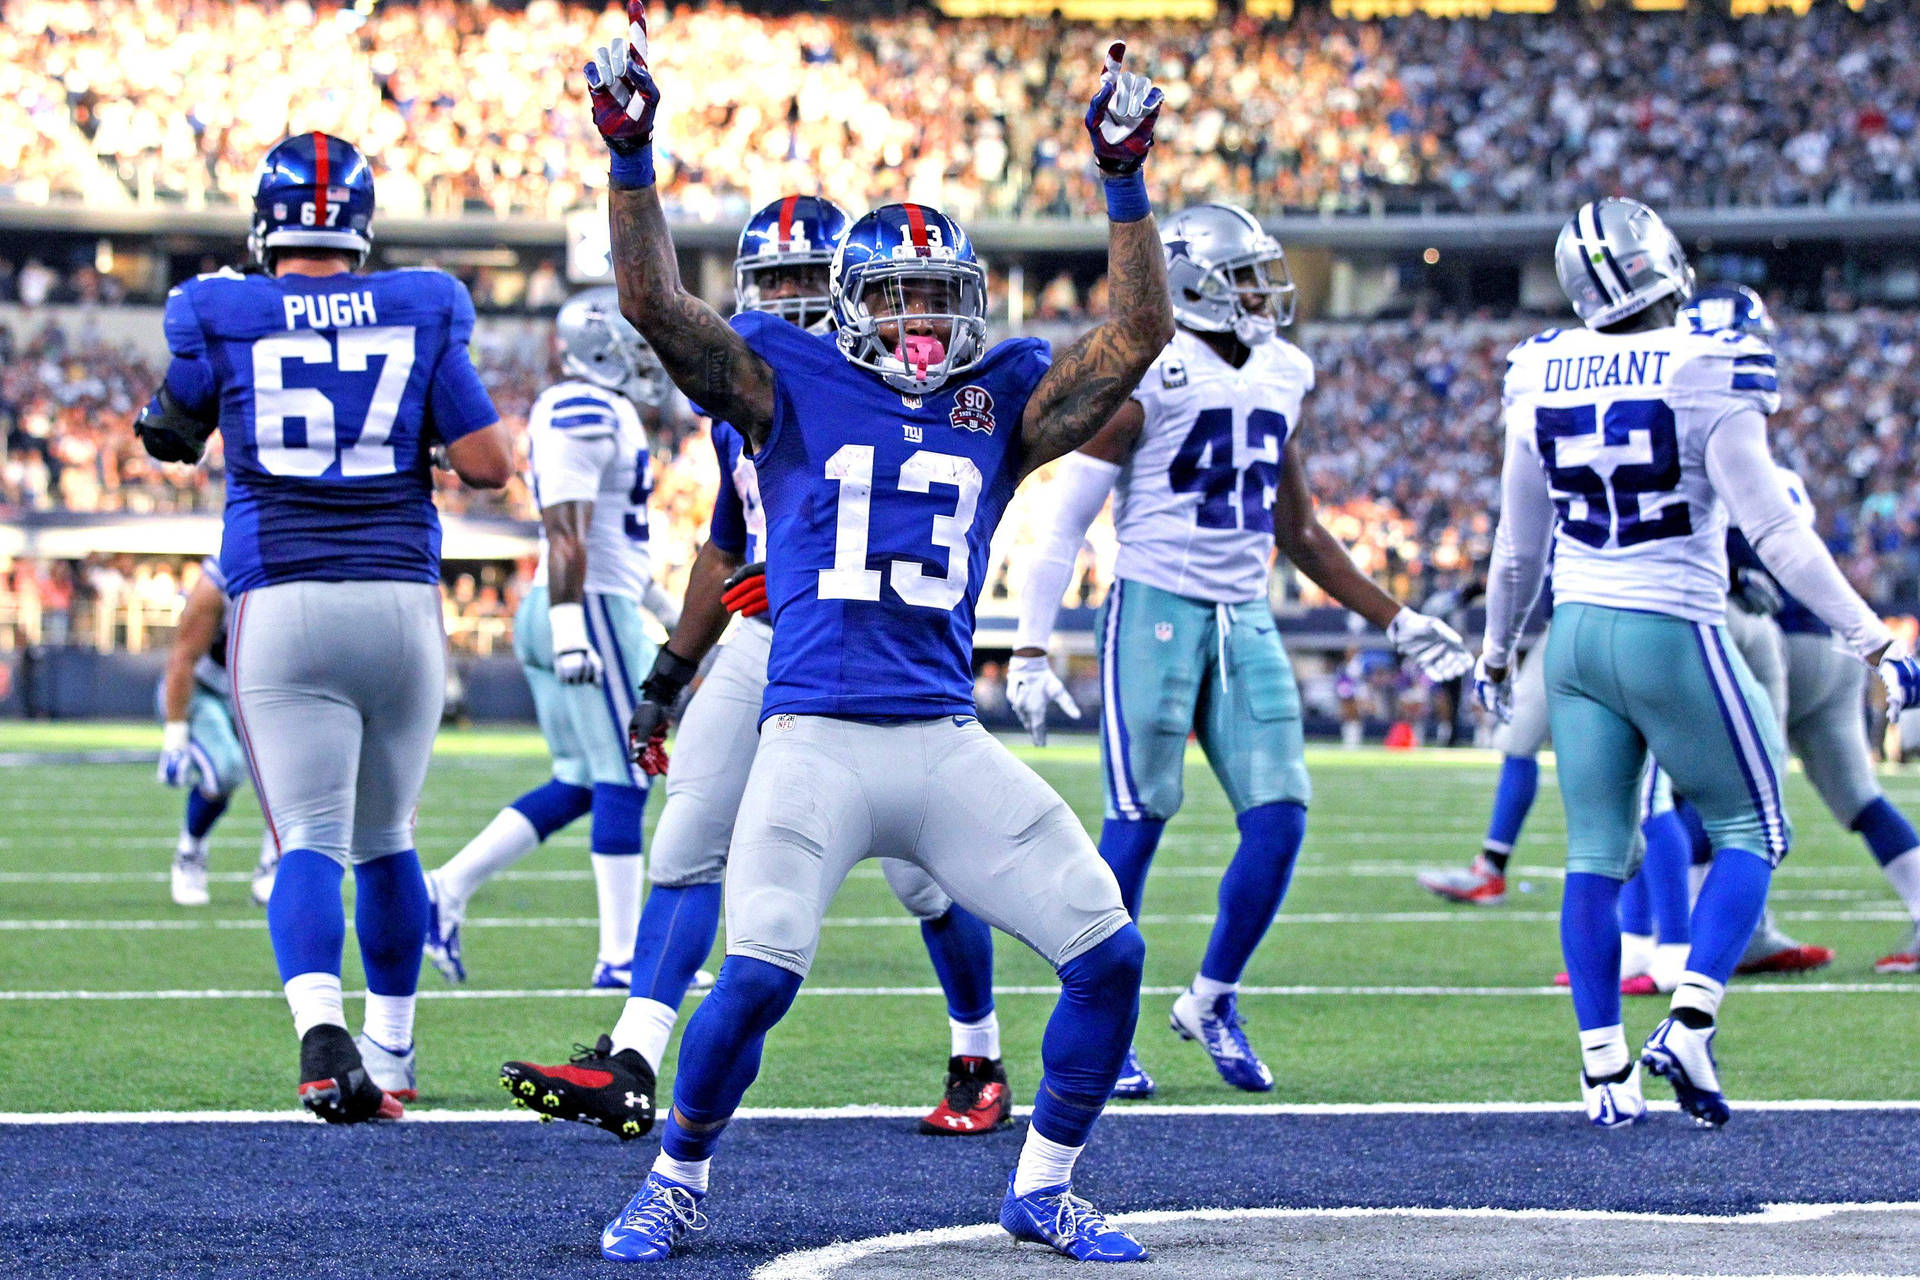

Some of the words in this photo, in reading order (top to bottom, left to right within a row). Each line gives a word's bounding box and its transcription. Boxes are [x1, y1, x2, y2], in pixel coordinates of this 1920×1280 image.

[301, 201, 341, 227] 67
[899, 224, 943, 248] 13
[282, 290, 378, 331] PUGH
[1162, 359, 1185, 382] C
[1544, 351, 1670, 393] DURANT
[252, 325, 416, 477] 67
[964, 389, 986, 409] 90
[1168, 407, 1288, 534] 42
[1535, 398, 1693, 548] 52
[817, 444, 983, 611] 13
